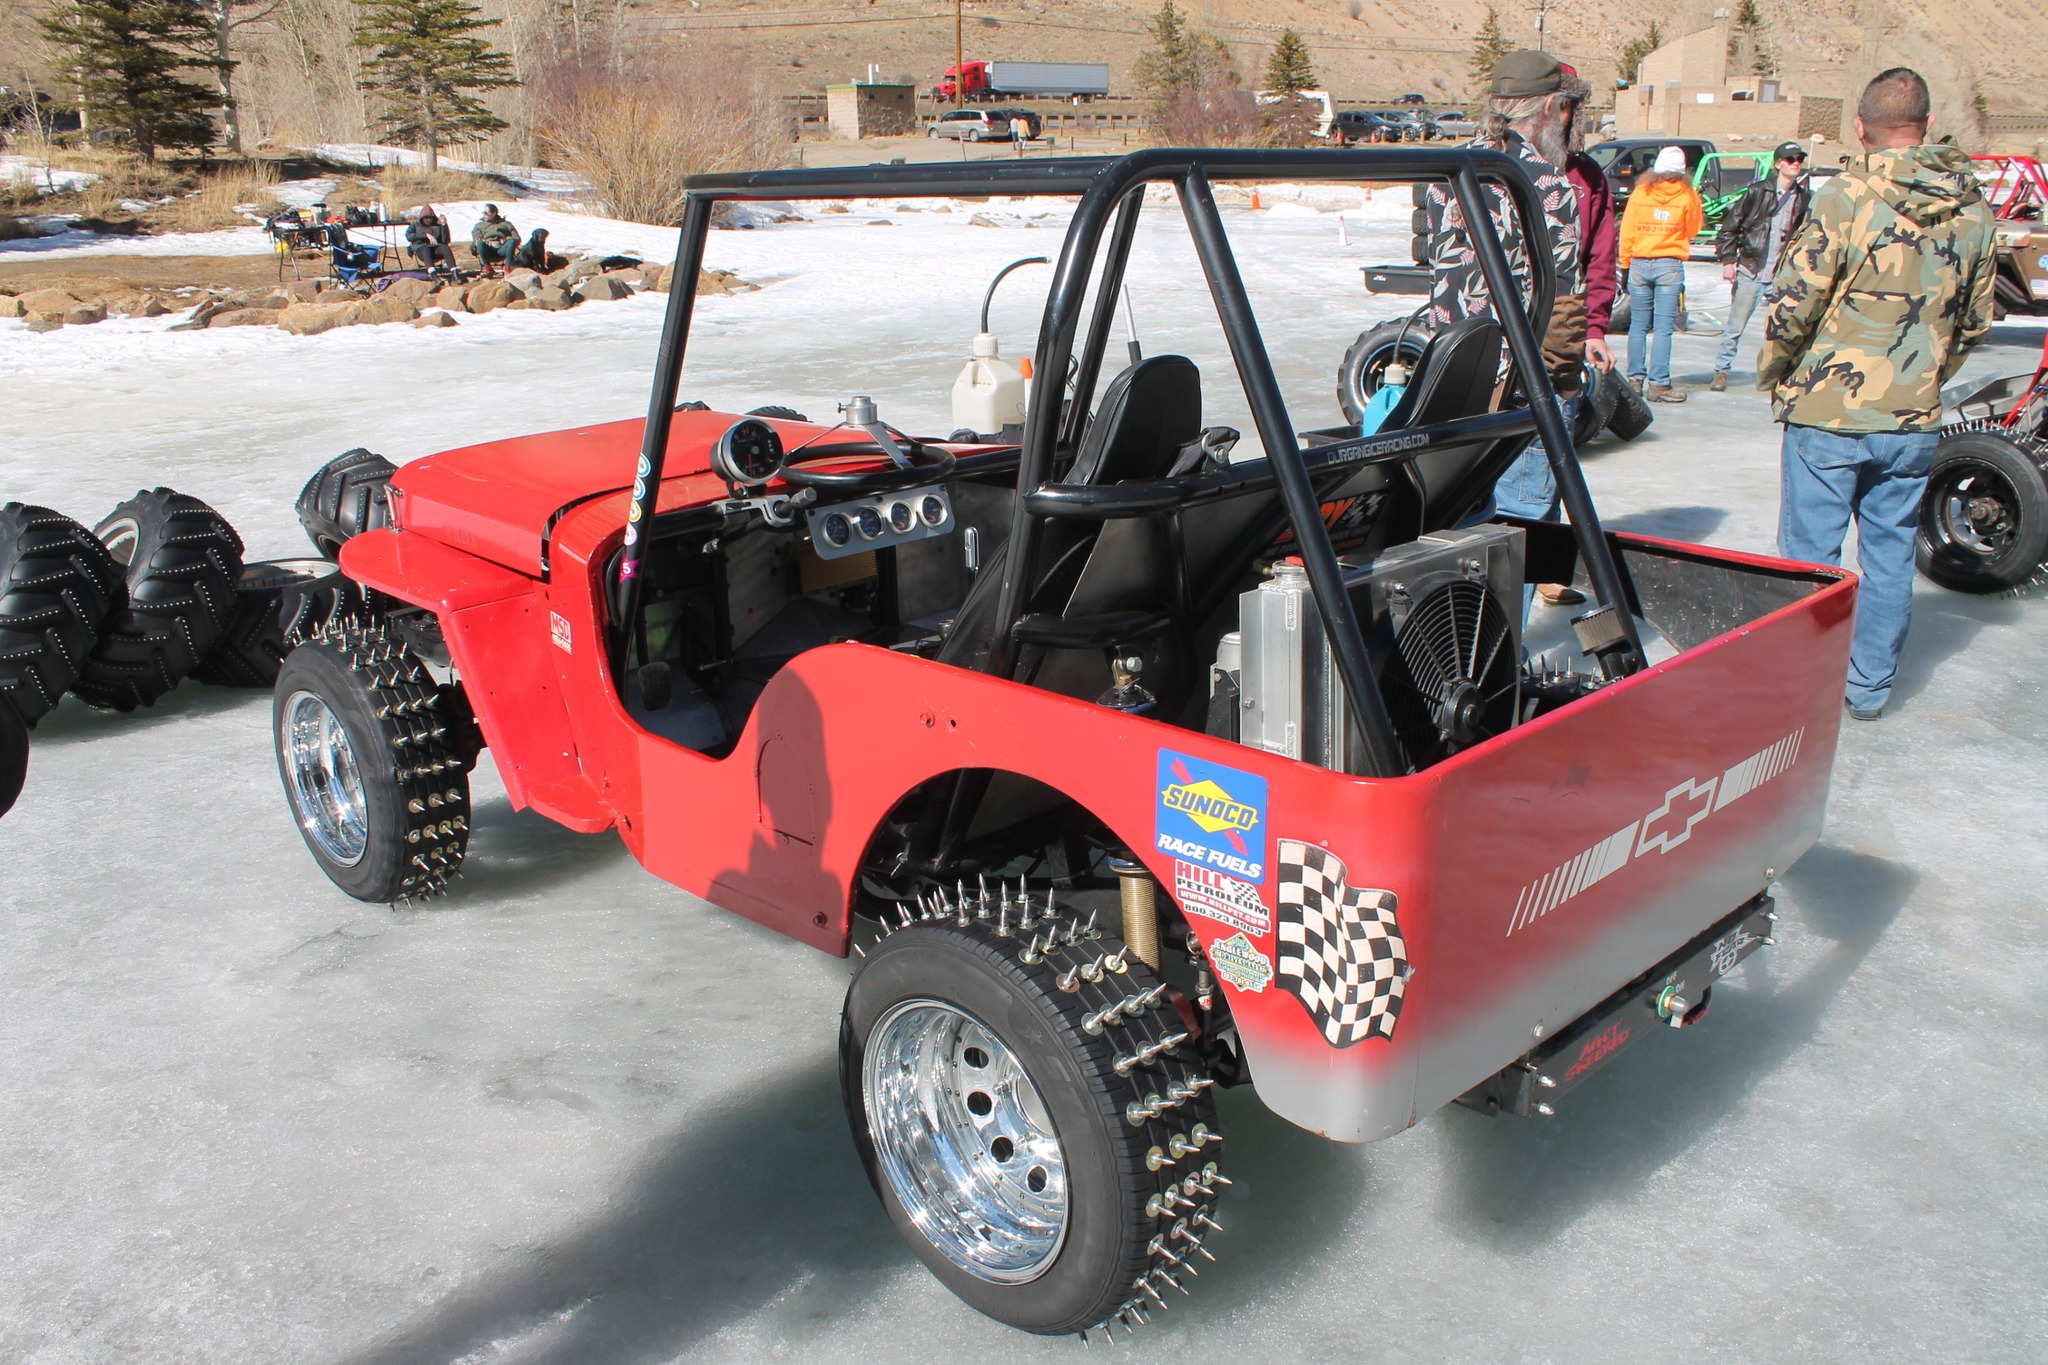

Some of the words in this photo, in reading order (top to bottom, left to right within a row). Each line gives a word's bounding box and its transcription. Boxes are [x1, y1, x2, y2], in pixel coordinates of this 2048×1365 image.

[622, 562, 632, 575] 5
[551, 612, 570, 641] MSD
[1165, 786, 1255, 828] SUNOCO
[1157, 832, 1208, 861] RACE
[1206, 848, 1263, 879] FUELS
[1176, 860, 1225, 891] HILL
[1176, 877, 1269, 917] PETROLEUM
[1179, 889, 1267, 928] WWW.HILLPET.COM
[1184, 902, 1263, 936] 800.323.8963
[1214, 939, 1268, 967] ENGLEWOOD
